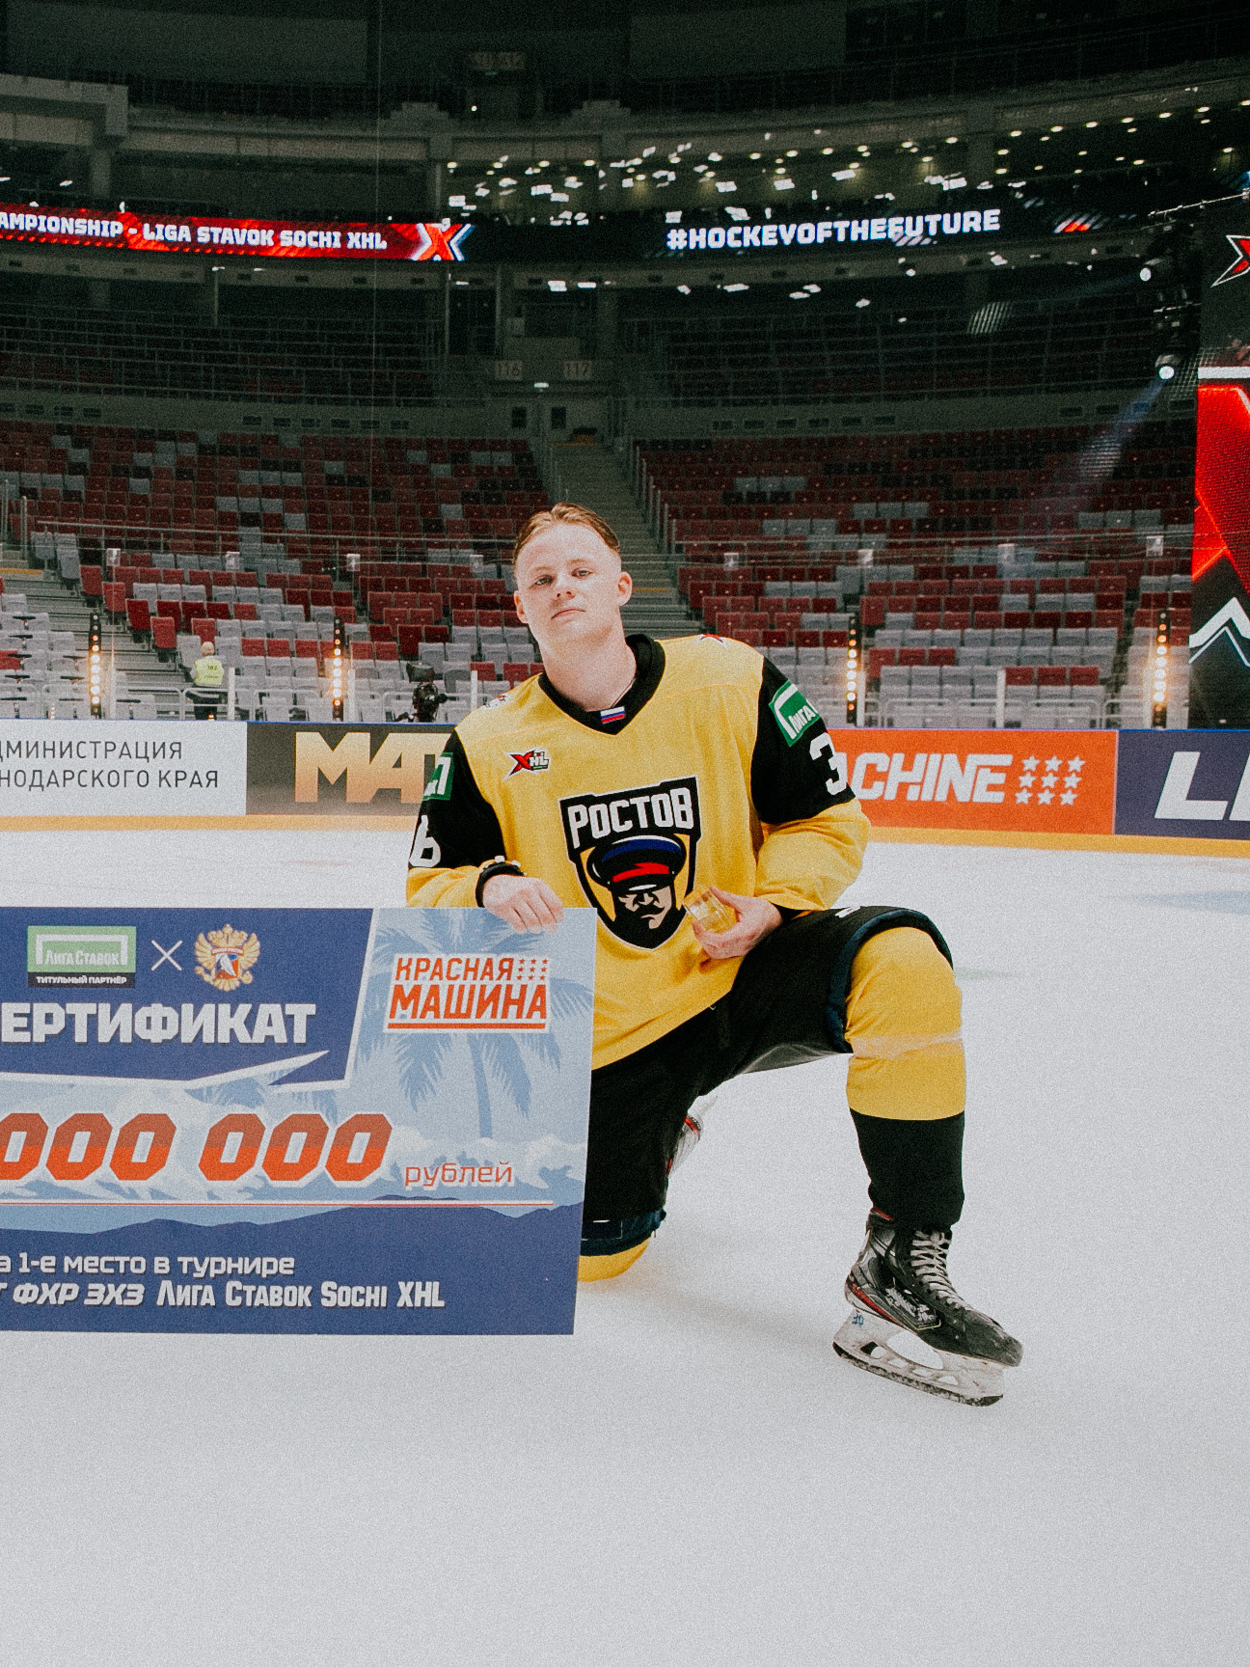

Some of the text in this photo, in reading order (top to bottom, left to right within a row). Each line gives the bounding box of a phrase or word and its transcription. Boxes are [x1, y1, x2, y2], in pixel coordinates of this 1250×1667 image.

[143, 223, 191, 242] LIGA
[197, 226, 275, 247] STAVOK
[280, 230, 341, 249] SOCHI
[347, 233, 388, 250] XHL
[667, 208, 1001, 250] #HOCKEYOFTHEFUTURE
[159, 770, 218, 788] КРАЯ
[507, 749, 550, 778] XHL
[810, 732, 848, 796] 3
[845, 751, 1013, 803] CHINE
[1154, 751, 1250, 821] L
[568, 787, 694, 848] РОСТОВ
[410, 815, 441, 868] 6
[36, 975, 87, 984] ТИТУЛЬНЫЙ
[394, 957, 514, 981] КРАСНАЯ
[389, 984, 546, 1019] МАШИНА
[198, 1113, 393, 1181] 000
[404, 1161, 512, 1187] рублей
[18, 1252, 56, 1273] 1-е
[63, 1255, 146, 1274] место
[153, 1256, 170, 1274] в
[177, 1256, 296, 1278] турнире
[12, 1282, 79, 1305] ФХР
[397, 1281, 446, 1307] XHL
